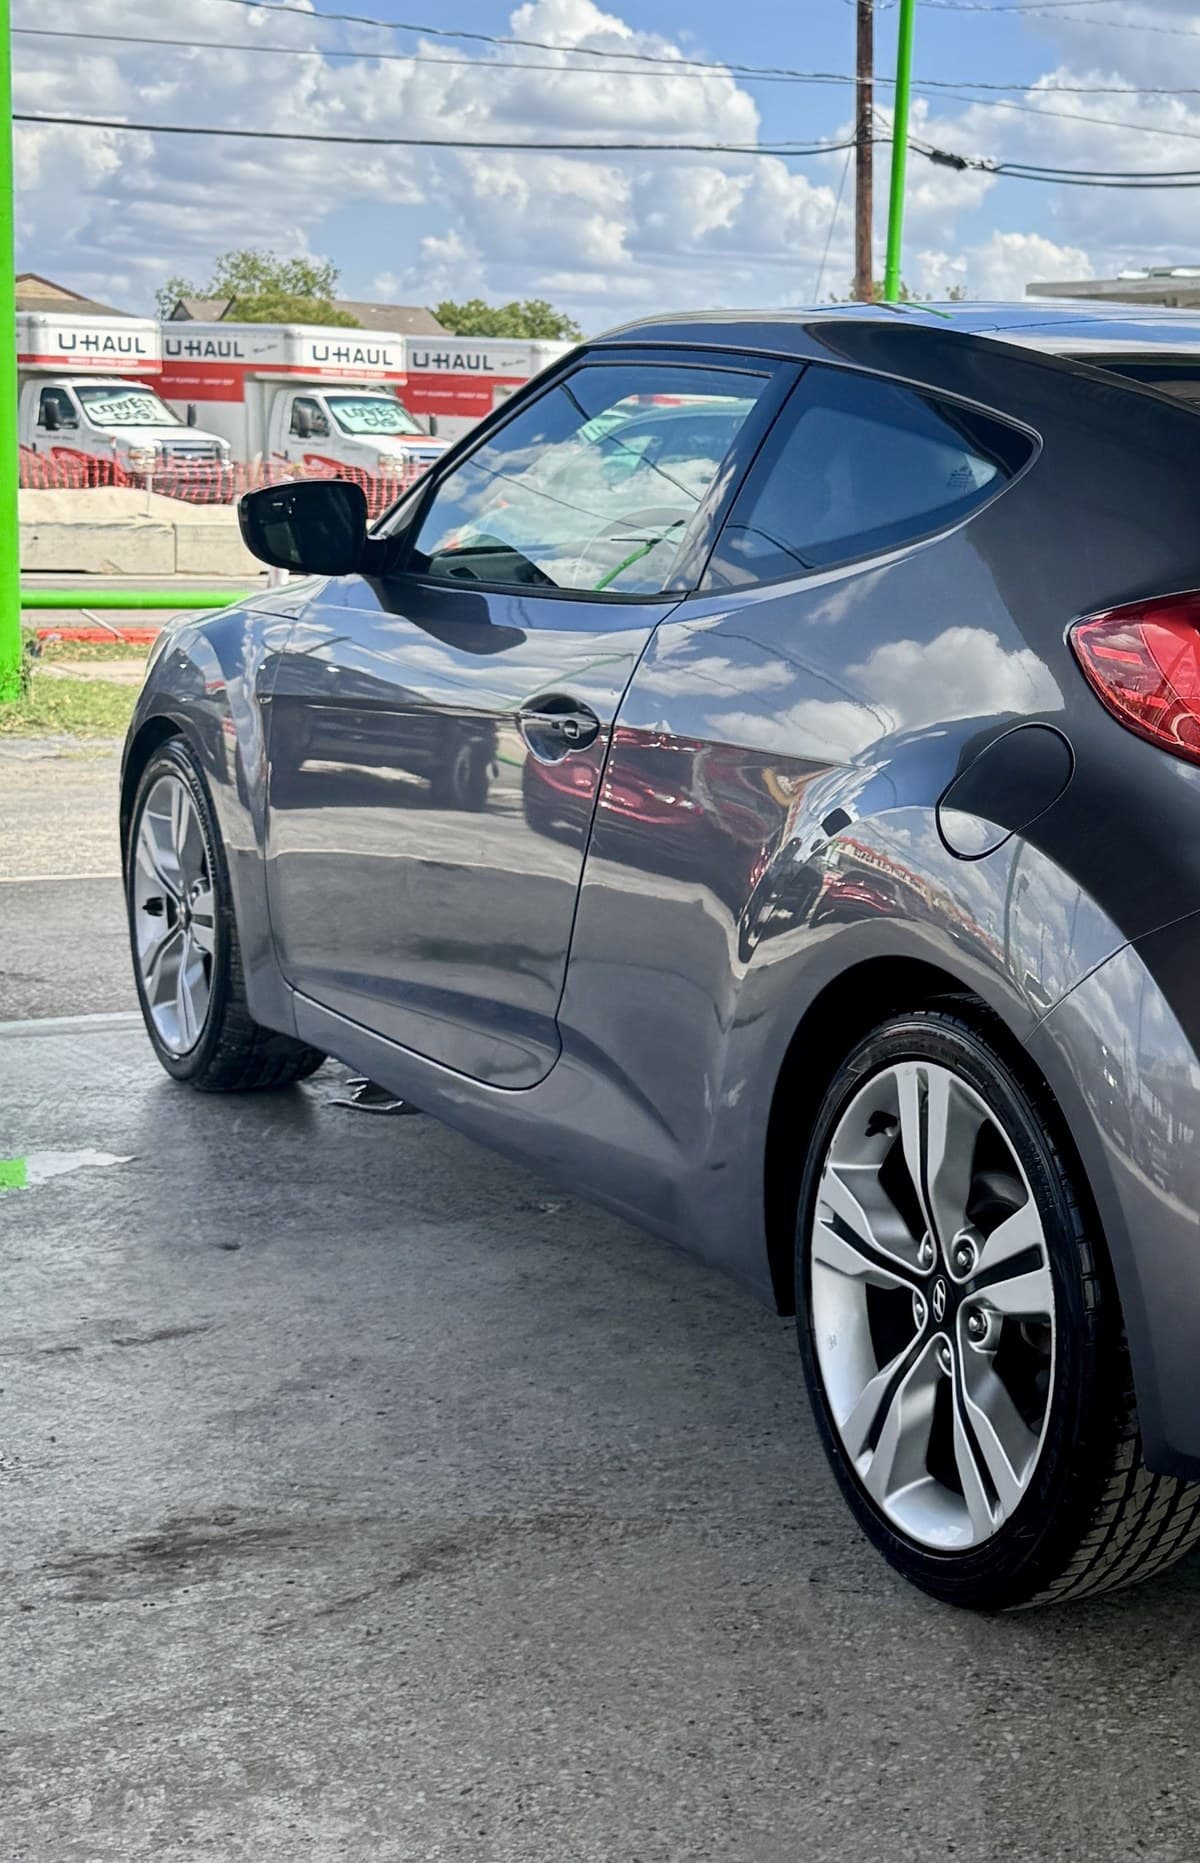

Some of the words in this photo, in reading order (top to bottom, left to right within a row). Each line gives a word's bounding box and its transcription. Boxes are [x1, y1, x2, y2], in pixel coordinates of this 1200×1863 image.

[58, 333, 146, 353] U-HAUL
[166, 339, 245, 357] U-HAUL
[312, 345, 393, 365] U-HAUL
[412, 352, 494, 370] U-HAUL
